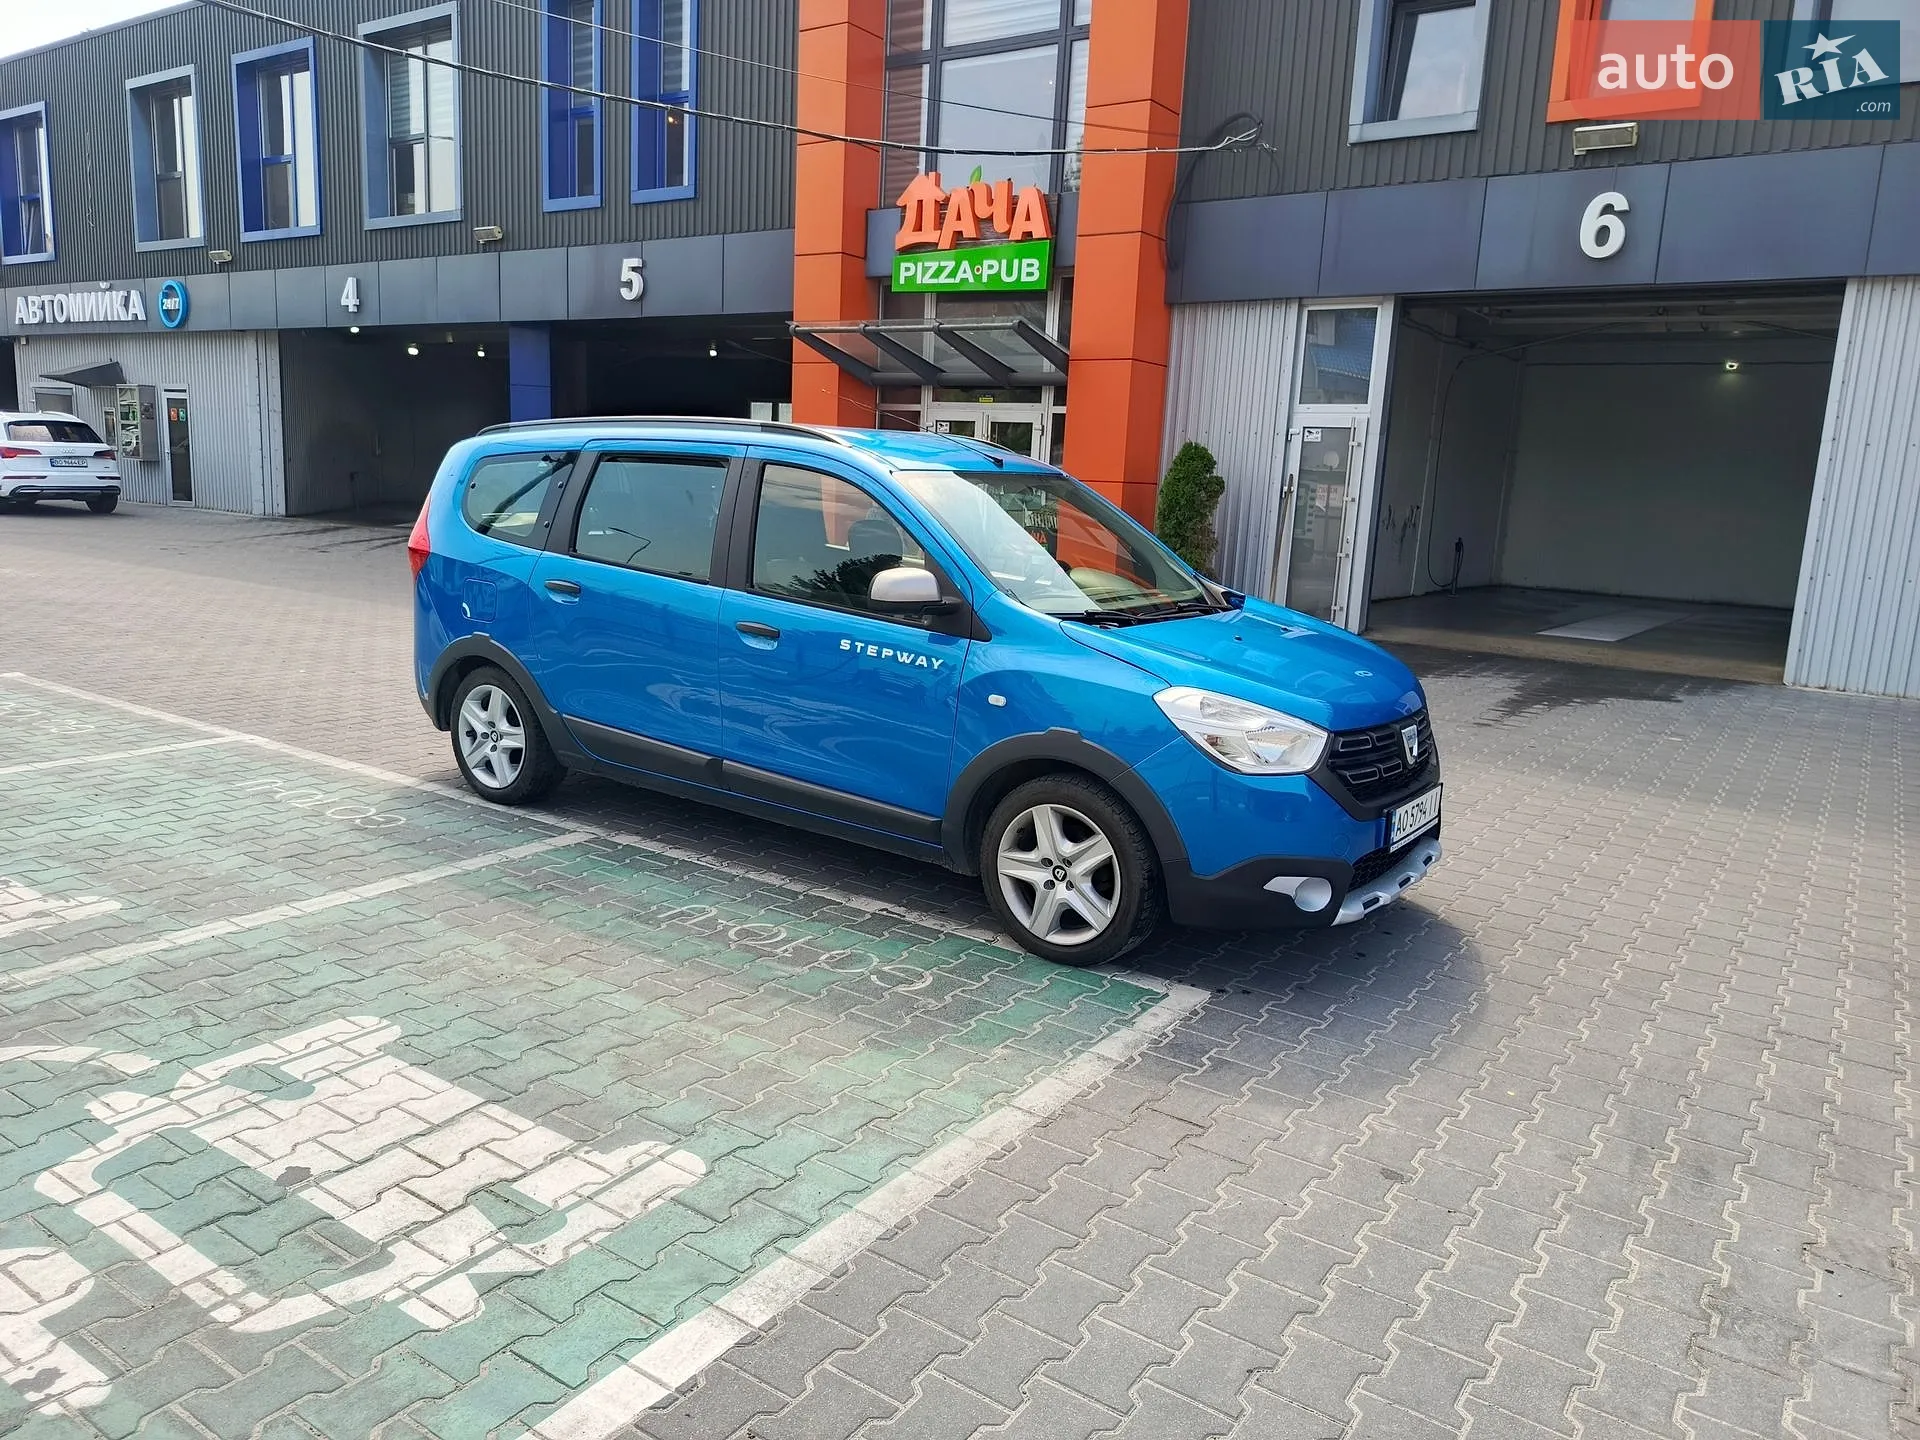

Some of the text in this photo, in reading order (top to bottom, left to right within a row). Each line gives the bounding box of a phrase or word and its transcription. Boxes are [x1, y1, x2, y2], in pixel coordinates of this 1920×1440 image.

[895, 172, 1052, 251] ДАЧА
[1579, 191, 1630, 259] 6
[620, 258, 644, 300] 5
[981, 258, 1040, 283] PUB
[15, 282, 146, 325] АВТОМИЙКА
[162, 297, 180, 311] 24/7
[340, 277, 360, 313] 4
[839, 639, 944, 670] STEPWAY
